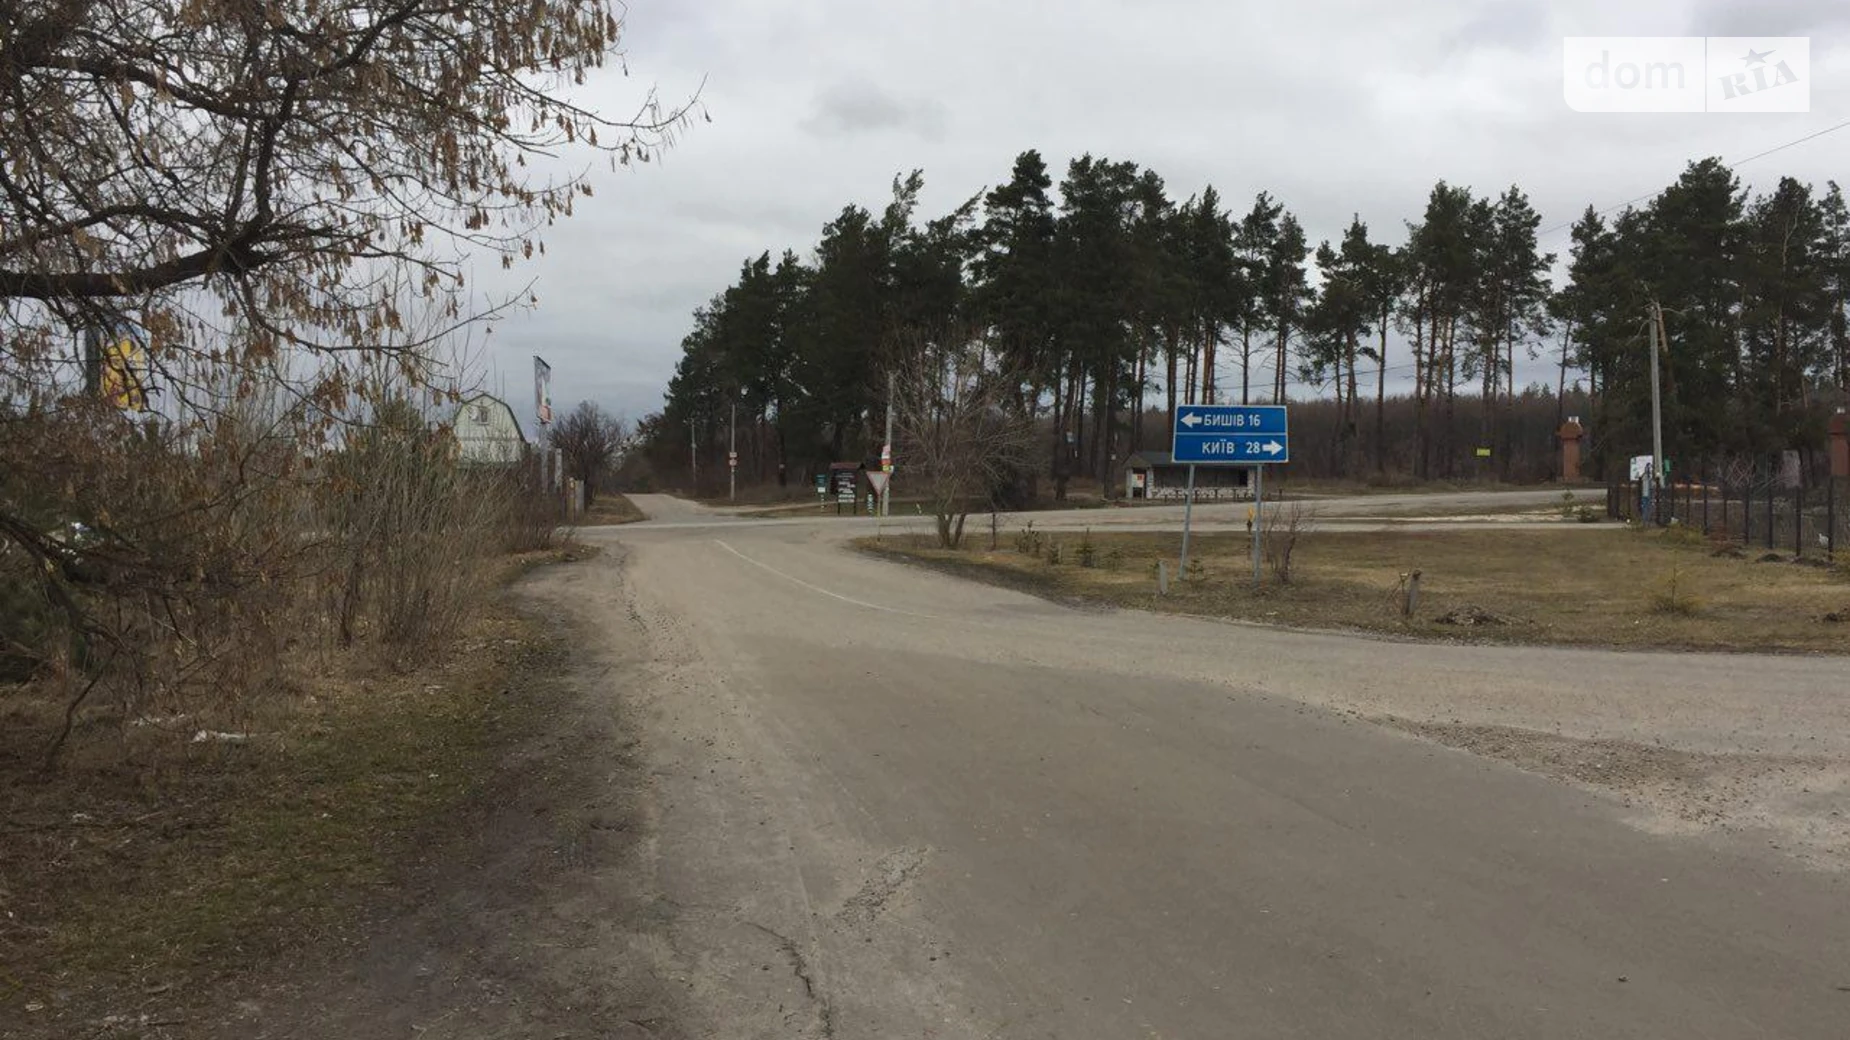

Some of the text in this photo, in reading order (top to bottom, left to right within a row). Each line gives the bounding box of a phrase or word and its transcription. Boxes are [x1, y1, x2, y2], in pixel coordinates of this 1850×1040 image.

[1204, 414, 1261, 427] БИШІВ 16
[1202, 439, 1261, 454] КИЇВ 28
